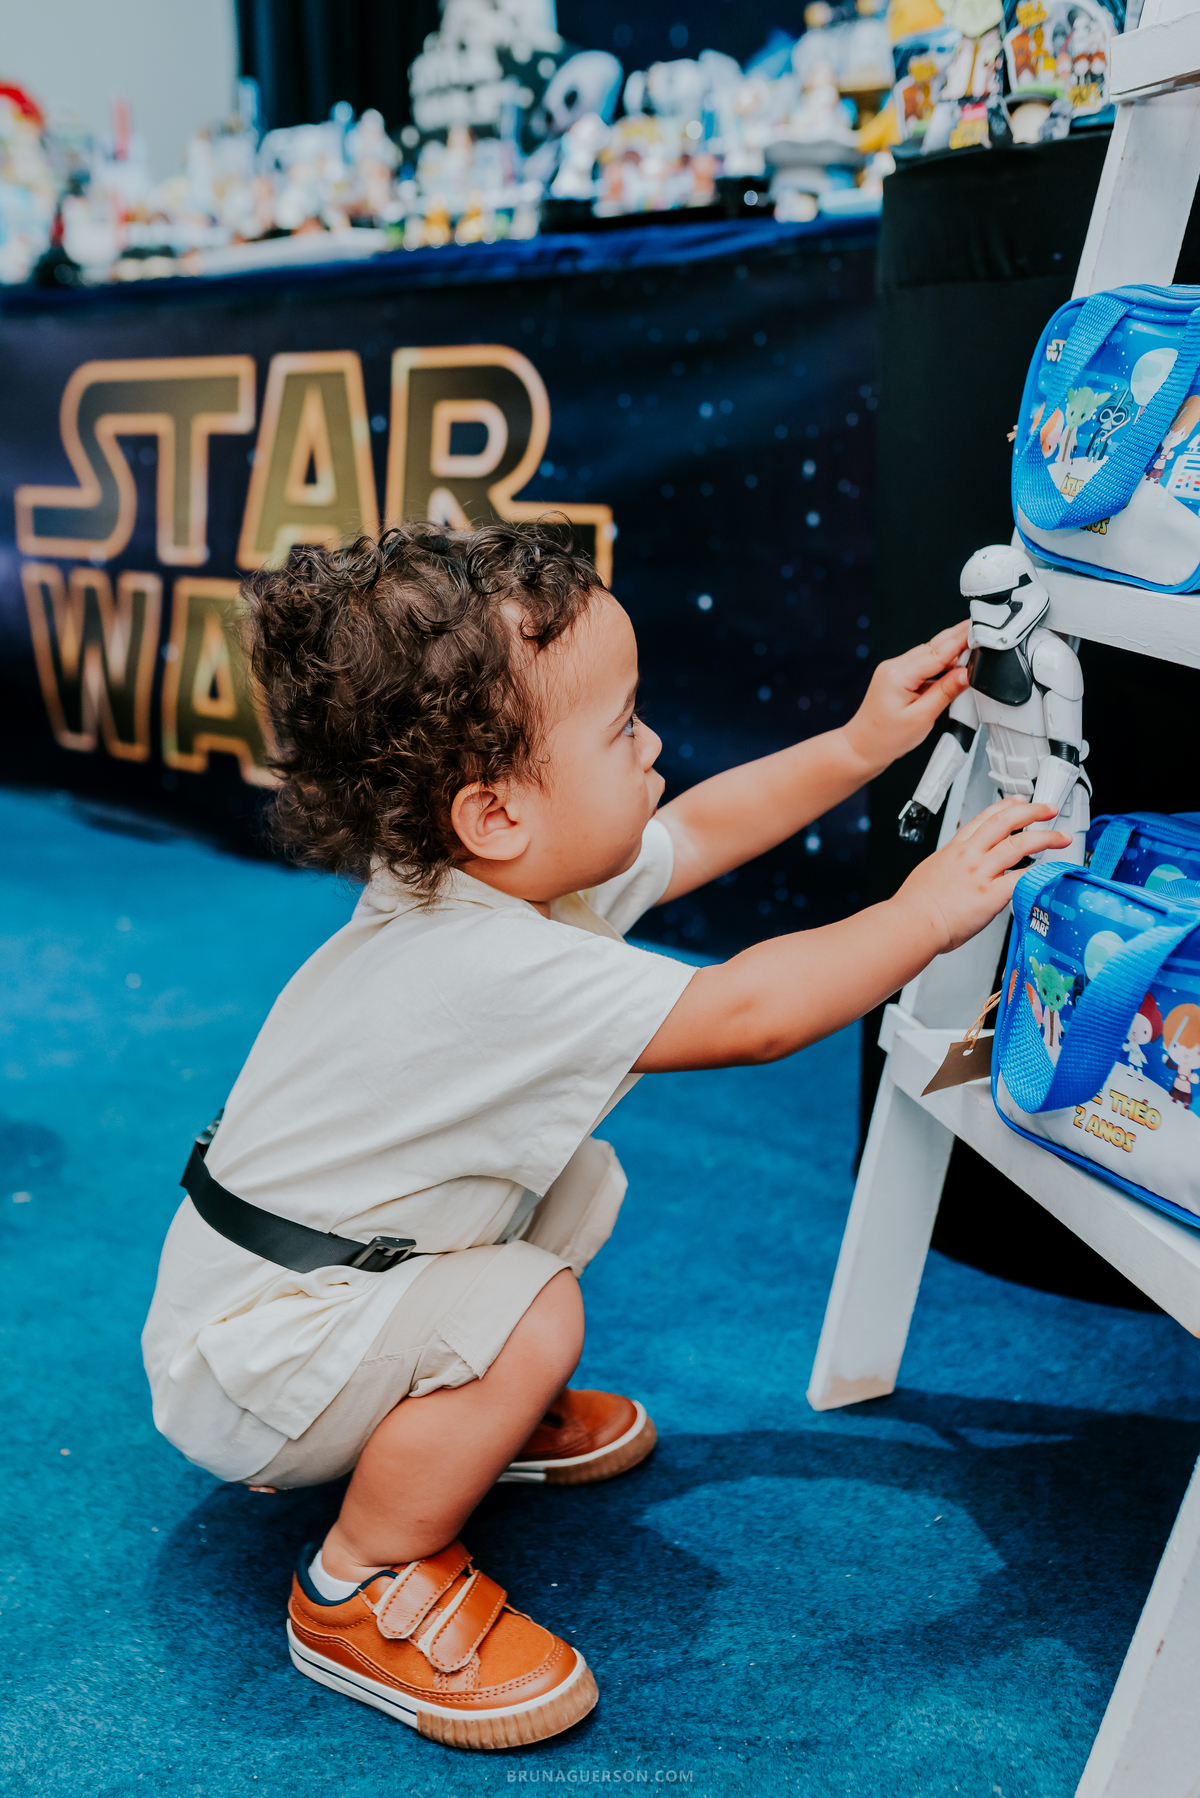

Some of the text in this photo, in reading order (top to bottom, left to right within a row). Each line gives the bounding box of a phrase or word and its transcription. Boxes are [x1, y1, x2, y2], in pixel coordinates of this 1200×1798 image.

[1046, 339, 1067, 351] ST
[14, 344, 613, 590] STAR
[1080, 517, 1110, 535] OS
[20, 560, 280, 788] WA
[1030, 917, 1050, 938] WARS
[1032, 905, 1050, 926] STAR
[1109, 1088, 1161, 1131] THÉO
[1073, 1105, 1136, 1153] 2 ANOS
